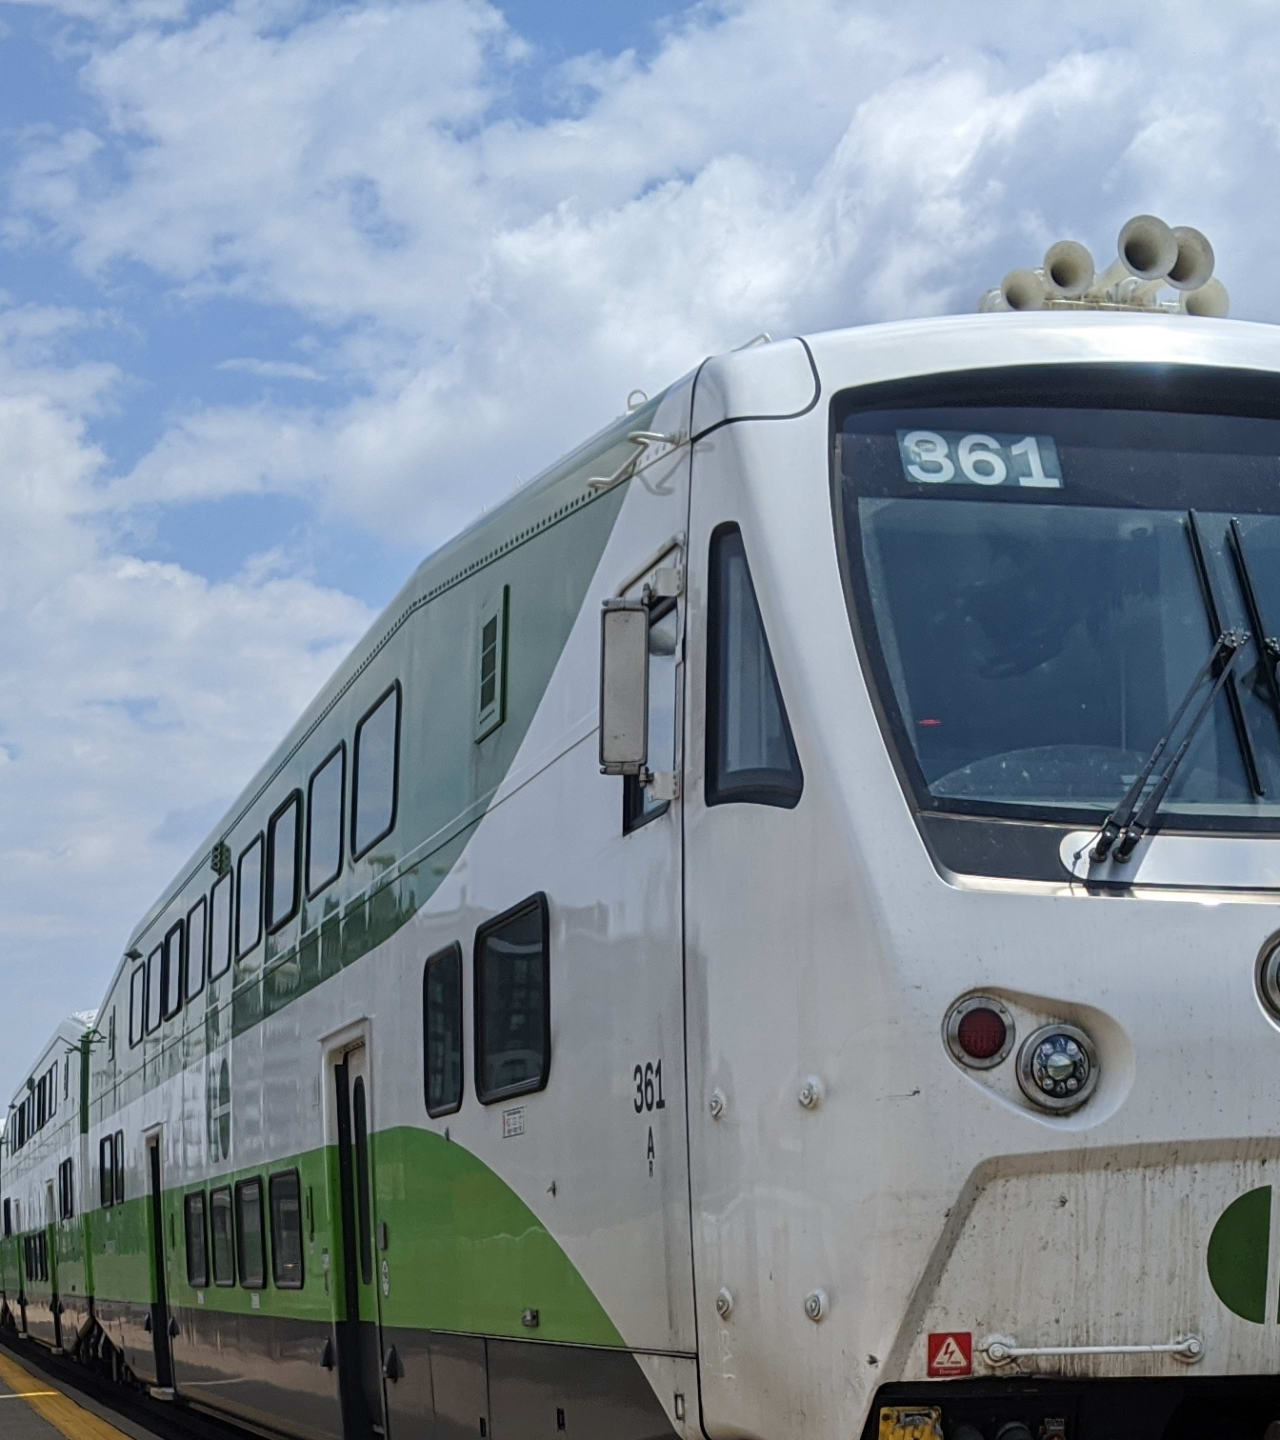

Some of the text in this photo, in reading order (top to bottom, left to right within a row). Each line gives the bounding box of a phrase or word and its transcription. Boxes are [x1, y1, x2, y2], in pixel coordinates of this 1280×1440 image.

[903, 430, 1061, 488] 361
[633, 1058, 666, 1114] 361
[646, 1125, 656, 1160] A
